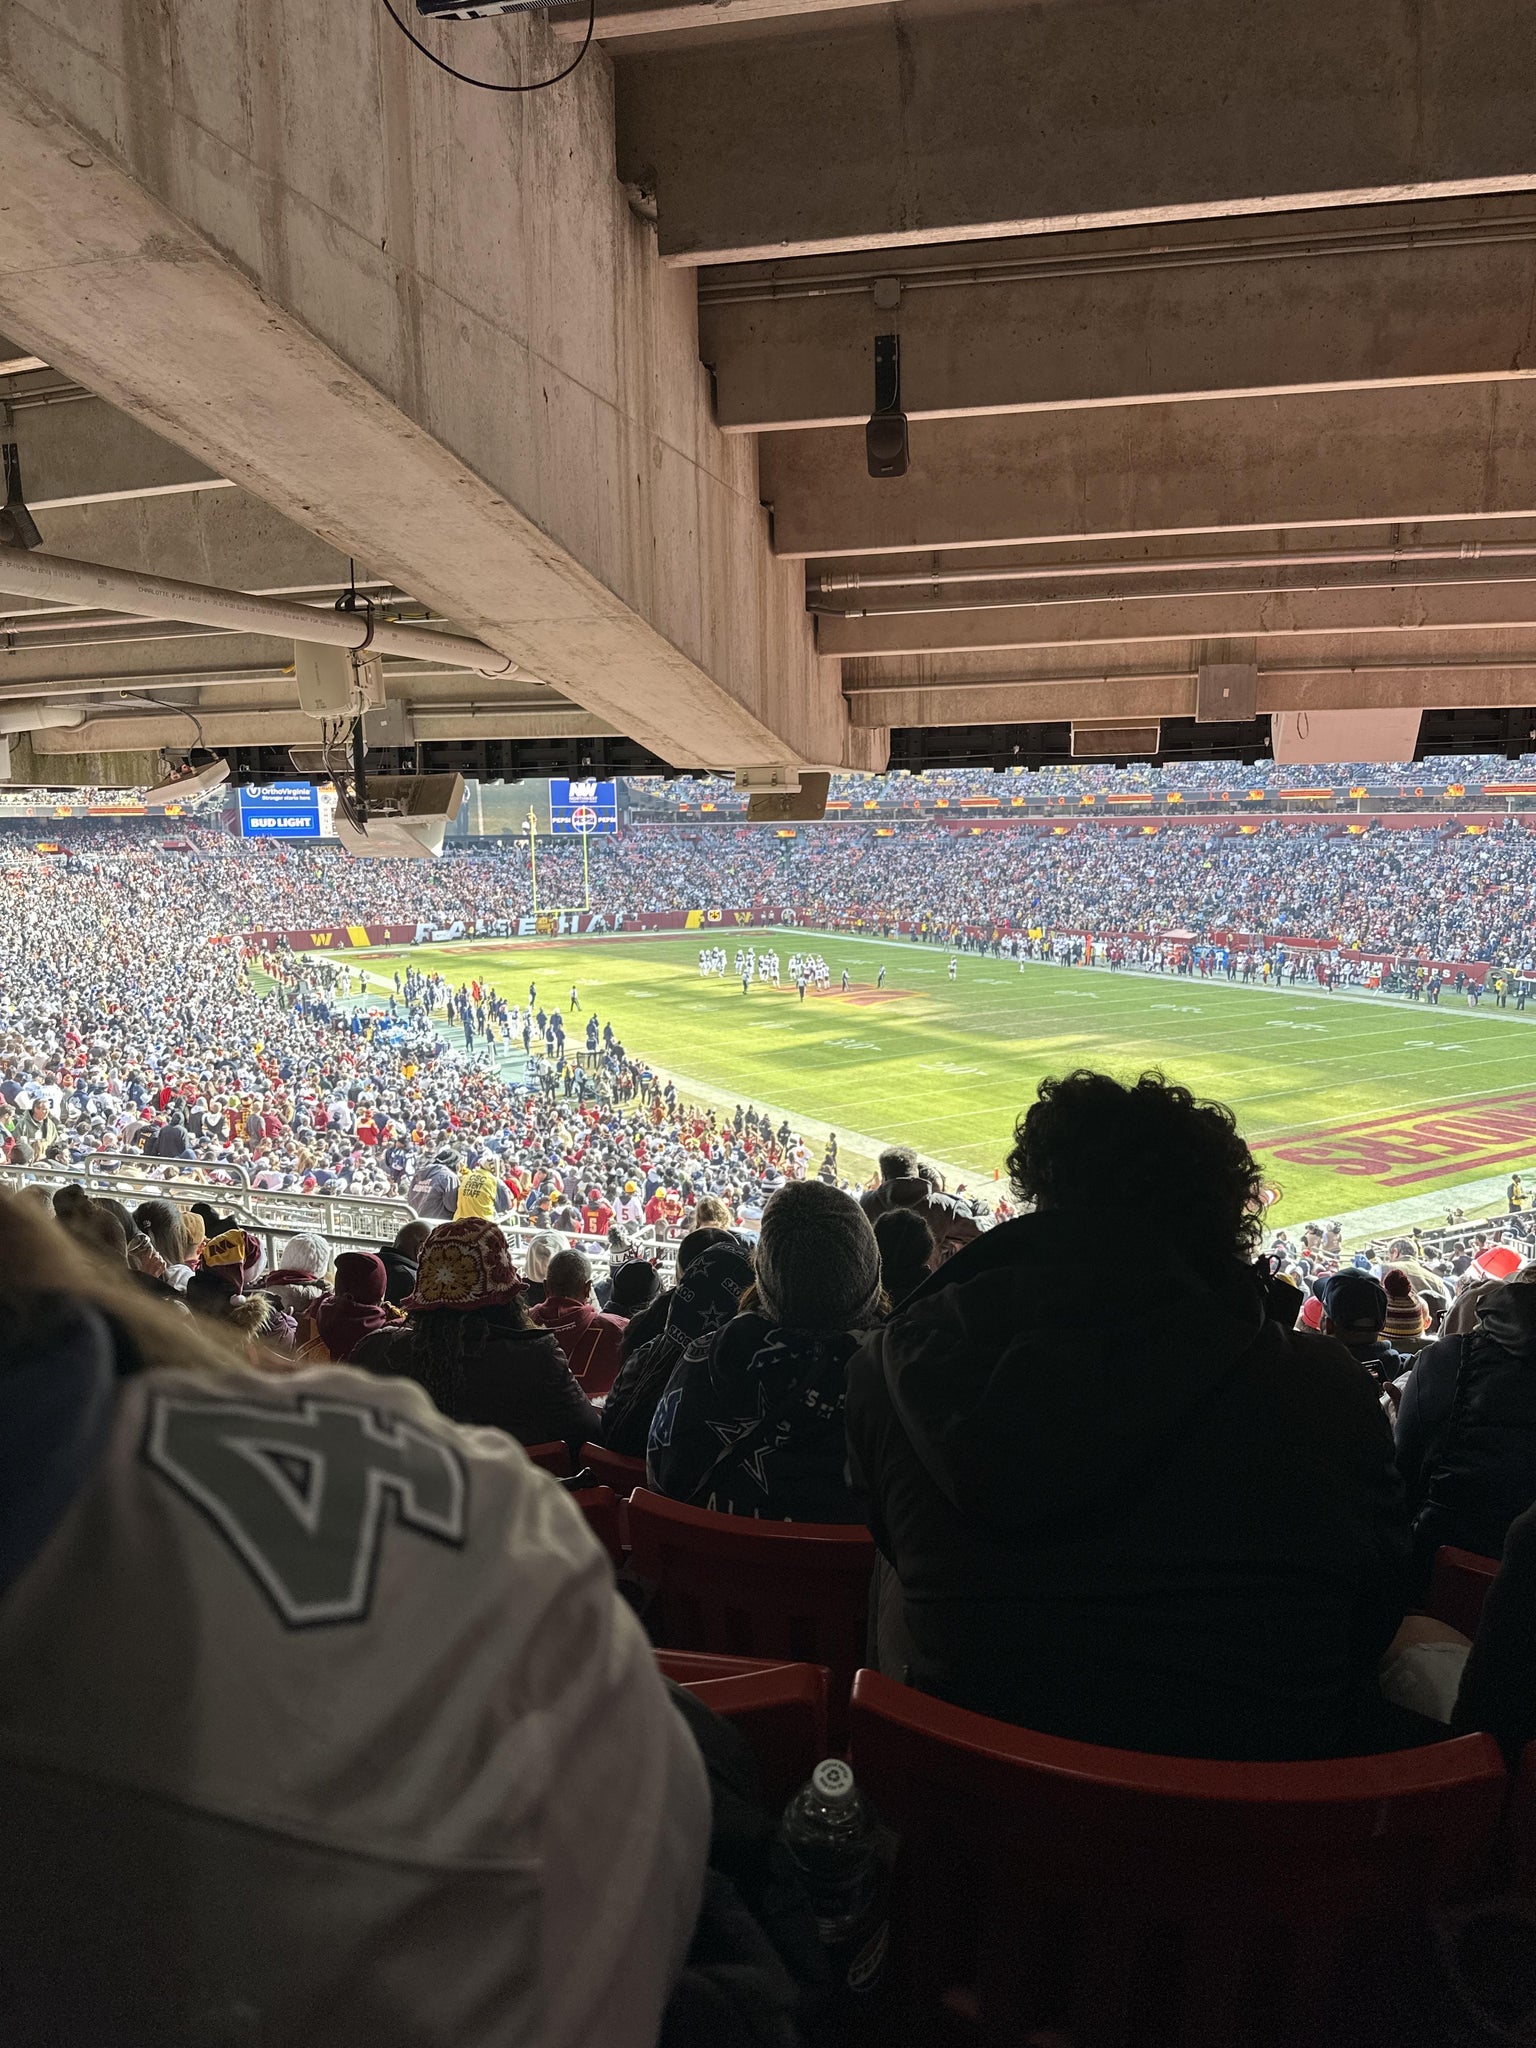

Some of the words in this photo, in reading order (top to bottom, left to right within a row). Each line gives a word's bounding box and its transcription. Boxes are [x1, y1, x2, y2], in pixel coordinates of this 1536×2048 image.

[261, 787, 311, 796] OrthoVirginia
[250, 818, 277, 828] BUD
[277, 817, 312, 827] LIGHT
[310, 933, 332, 947] W
[469, 1174, 487, 1183] CSC
[464, 1181, 484, 1190] EVENT
[462, 1189, 481, 1199] STAFF
[621, 1208, 630, 1221] 5
[588, 1217, 598, 1233] 5
[140, 1394, 468, 1634] 4
